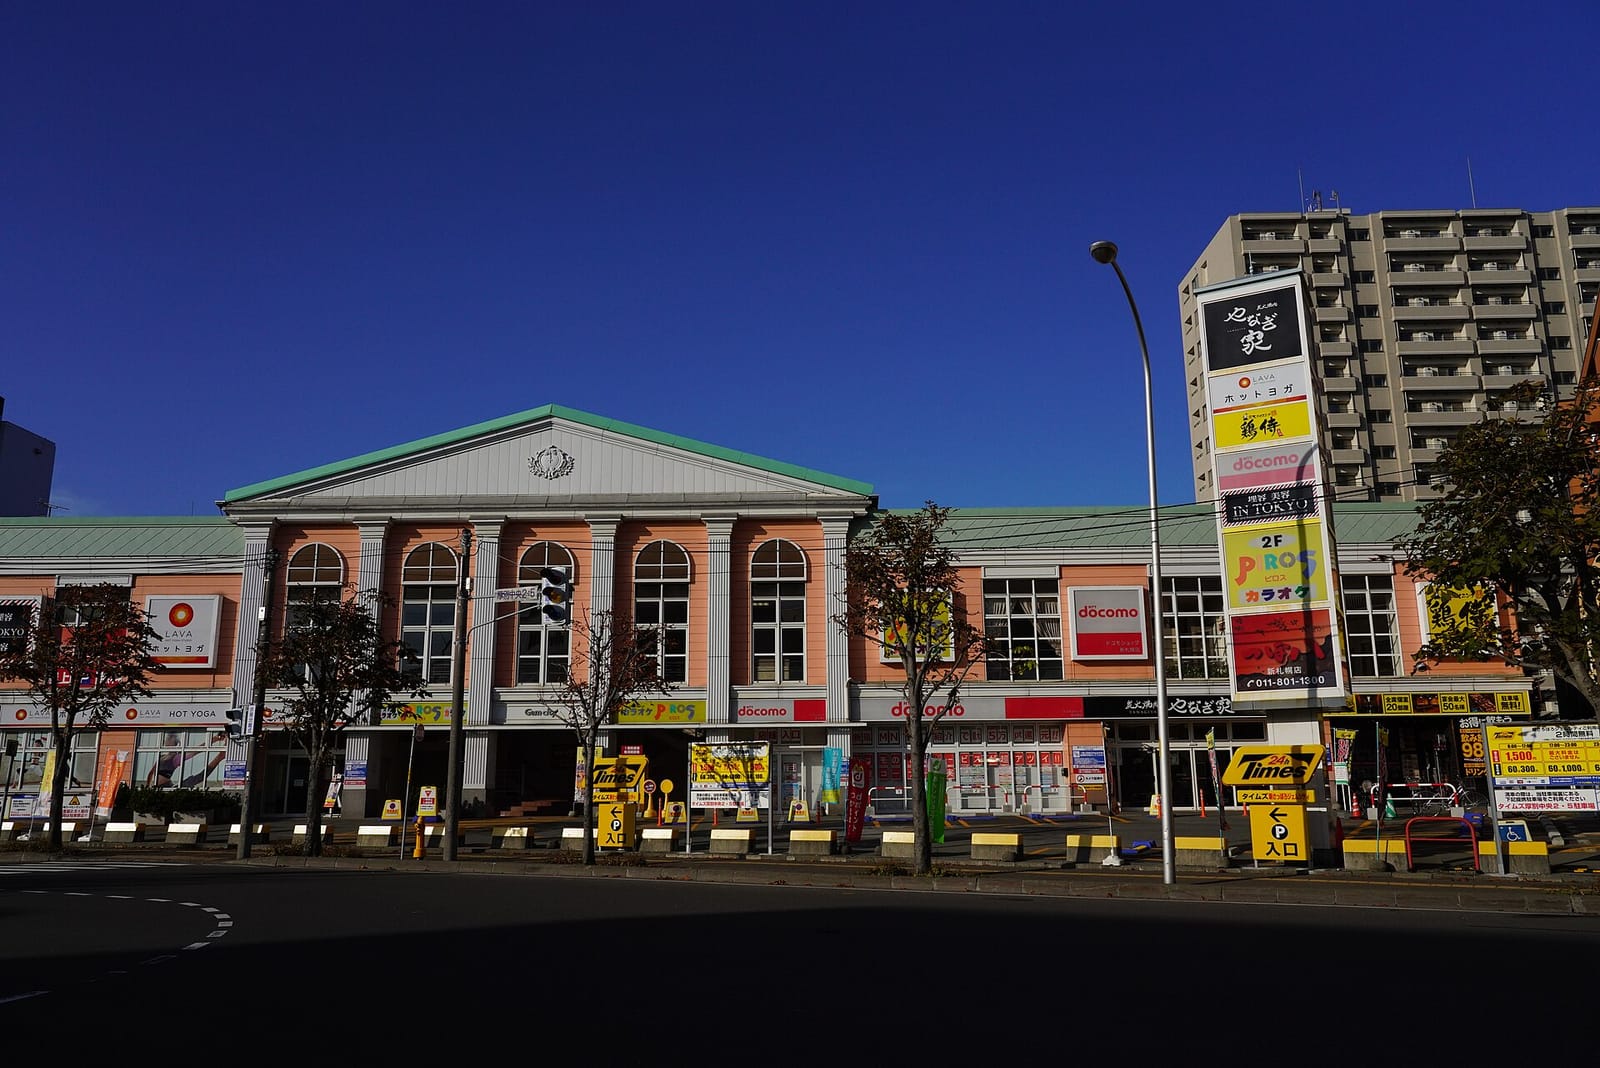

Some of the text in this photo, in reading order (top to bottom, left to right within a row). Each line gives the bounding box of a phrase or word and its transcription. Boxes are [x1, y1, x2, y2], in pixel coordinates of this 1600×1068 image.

[1253, 374, 1275, 382] LAVA
[1224, 384, 1294, 404] ホットヨガ
[1240, 417, 1280, 441] 鶏侍
[1233, 454, 1298, 471] docomo
[1233, 505, 1250, 517] IN
[1252, 499, 1308, 515] TOKYO
[1262, 535, 1283, 548] 2F
[1235, 550, 1317, 586] PIROS
[1246, 585, 1310, 602] カラオケ
[1078, 606, 1138, 618] docomo
[152, 644, 204, 652] ホットヨガ
[1267, 666, 1302, 676] 新札幌店
[1256, 675, 1325, 688] 011-801-1300
[738, 706, 787, 716] docomo
[891, 702, 964, 717] doomo
[1268, 756, 1290, 765] 24h
[1242, 761, 1308, 780] Times
[606, 833, 627, 844] 入口
[1275, 826, 1286, 838] P
[1266, 842, 1298, 856] 入口
